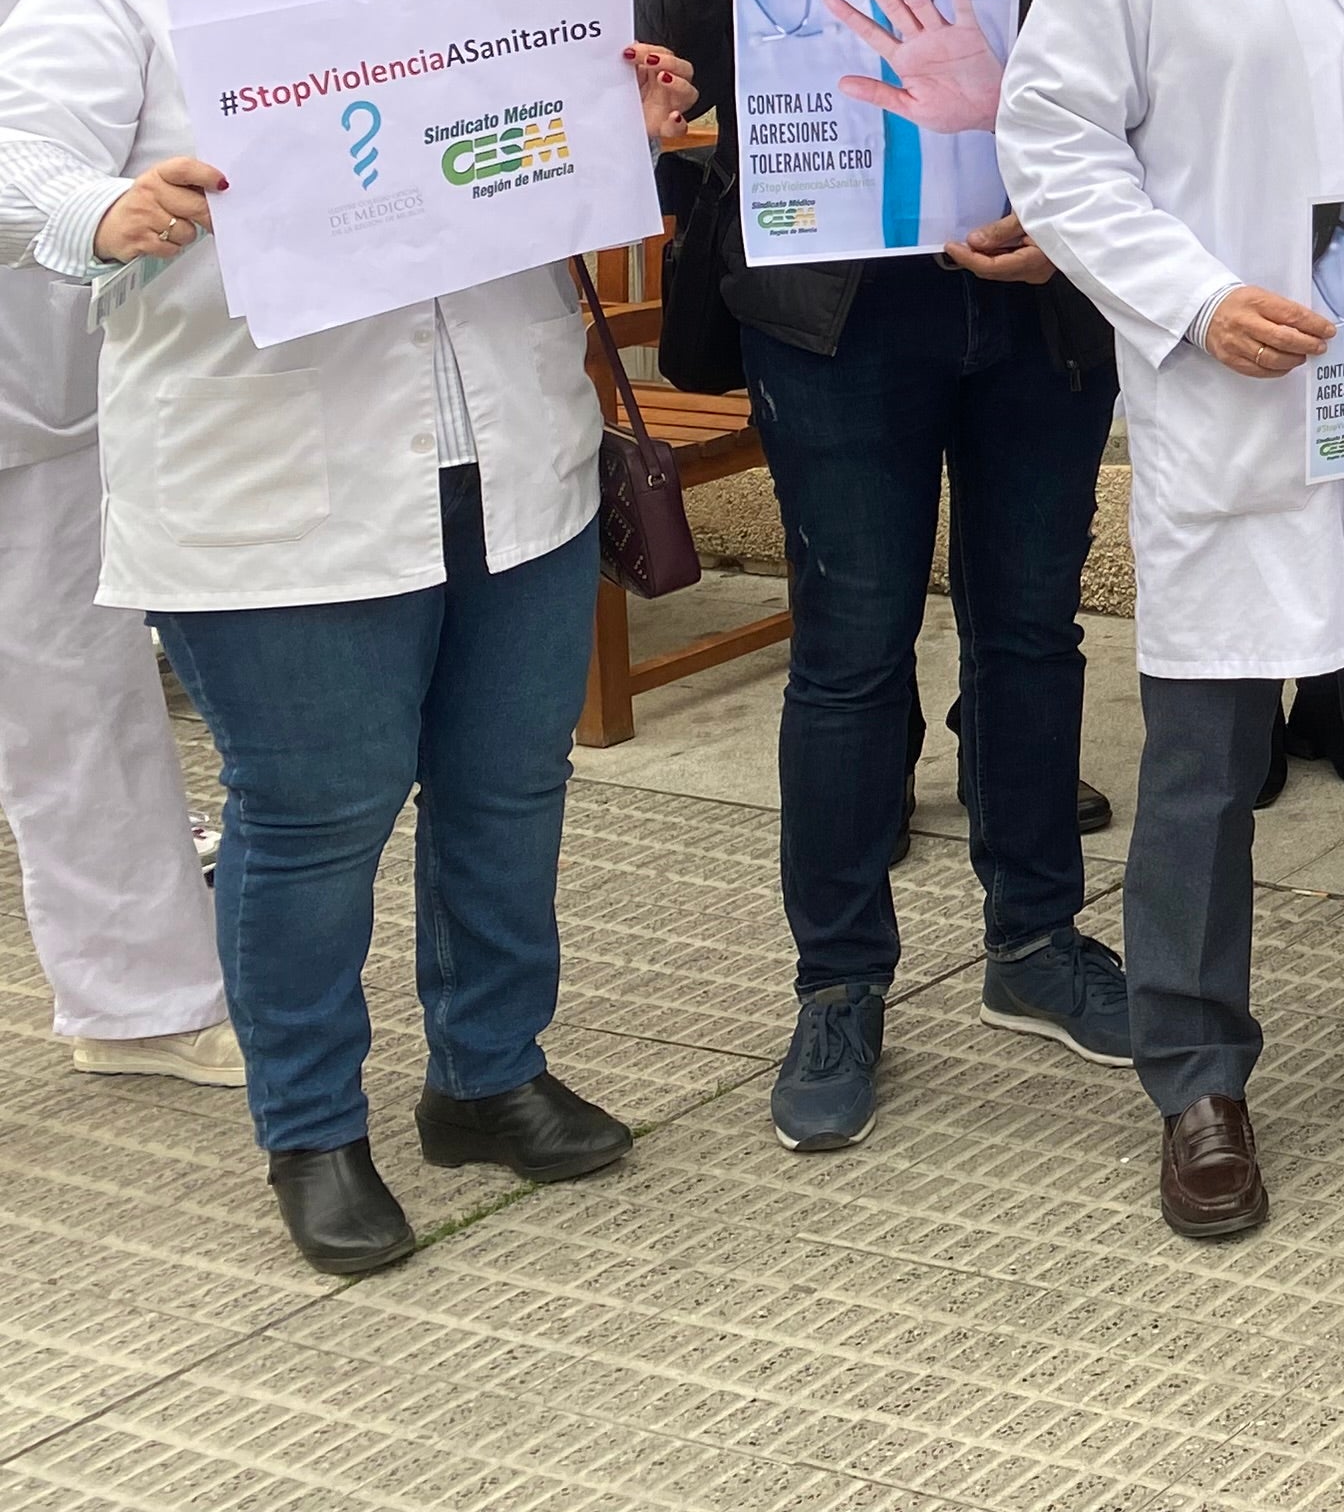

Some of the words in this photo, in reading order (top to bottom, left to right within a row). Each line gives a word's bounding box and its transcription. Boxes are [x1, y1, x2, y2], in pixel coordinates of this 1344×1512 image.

[220, 18, 602, 116] #StopViolenciaASanitarios
[748, 93, 803, 115] CONTRA
[807, 92, 833, 113] LAS
[424, 114, 499, 145] Sindicato
[504, 100, 564, 125] Médico
[750, 121, 838, 145] AGRESIONES
[442, 118, 569, 186] CESM
[750, 151, 835, 174] TOLERANCIA
[839, 149, 873, 170] CERO
[472, 177, 512, 199] Región
[515, 174, 529, 188] de
[533, 162, 575, 183] Murcia
[330, 213, 349, 228] DE
